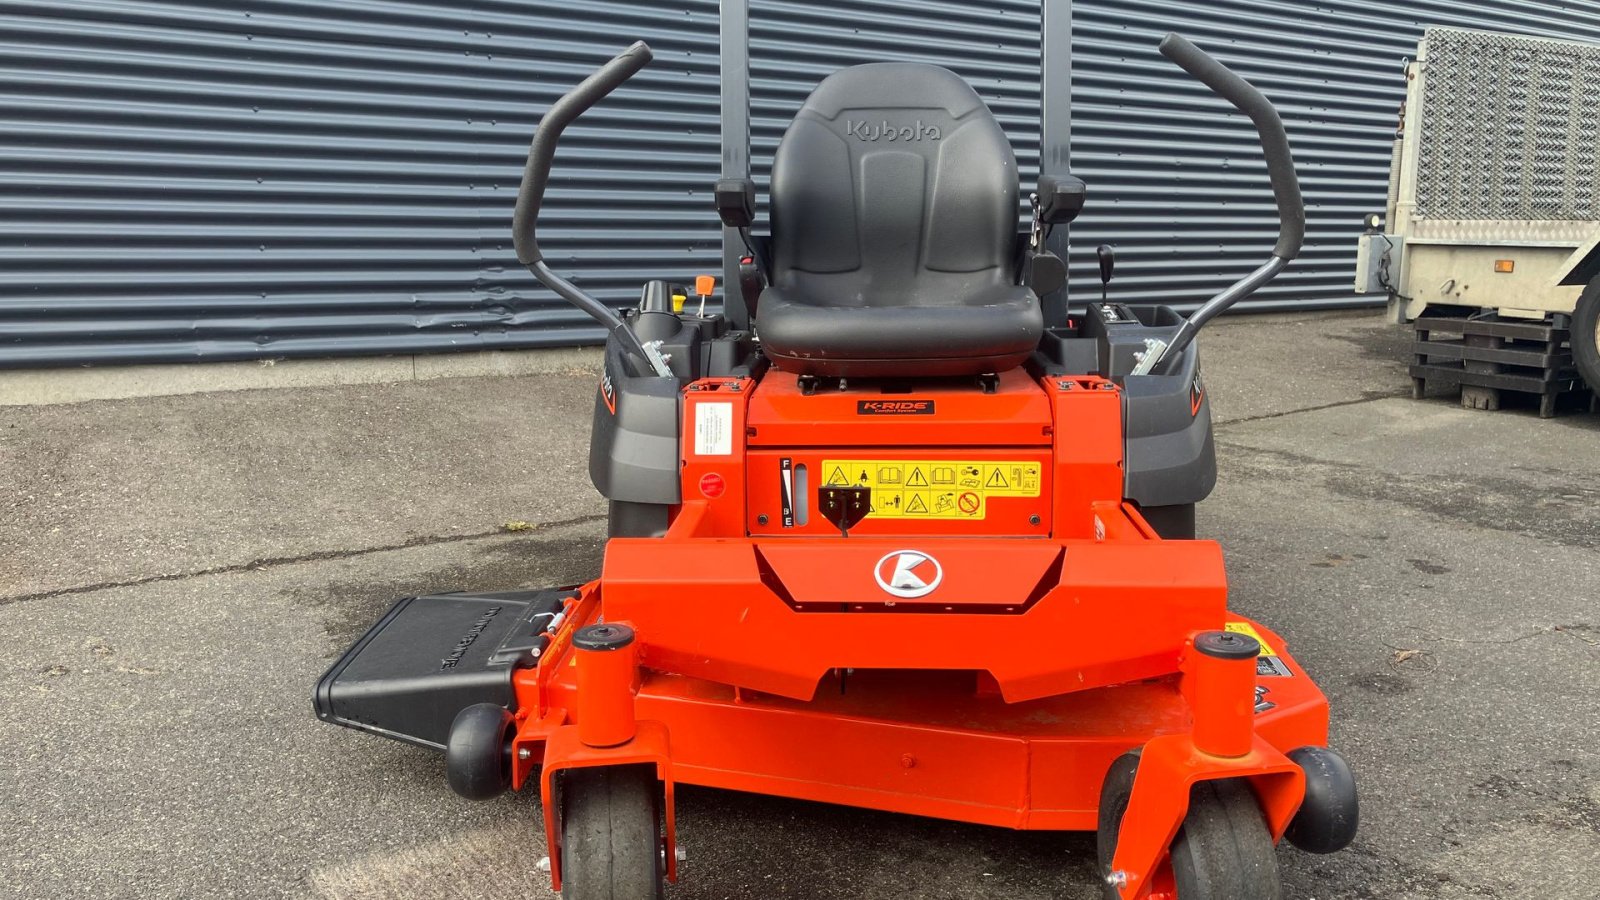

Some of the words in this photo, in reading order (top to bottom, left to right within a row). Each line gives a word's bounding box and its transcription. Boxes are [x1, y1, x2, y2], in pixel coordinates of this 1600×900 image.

[847, 120, 942, 141] Kubota
[863, 402, 928, 410] K-RIDE
[783, 460, 790, 468] F
[785, 517, 792, 526] E
